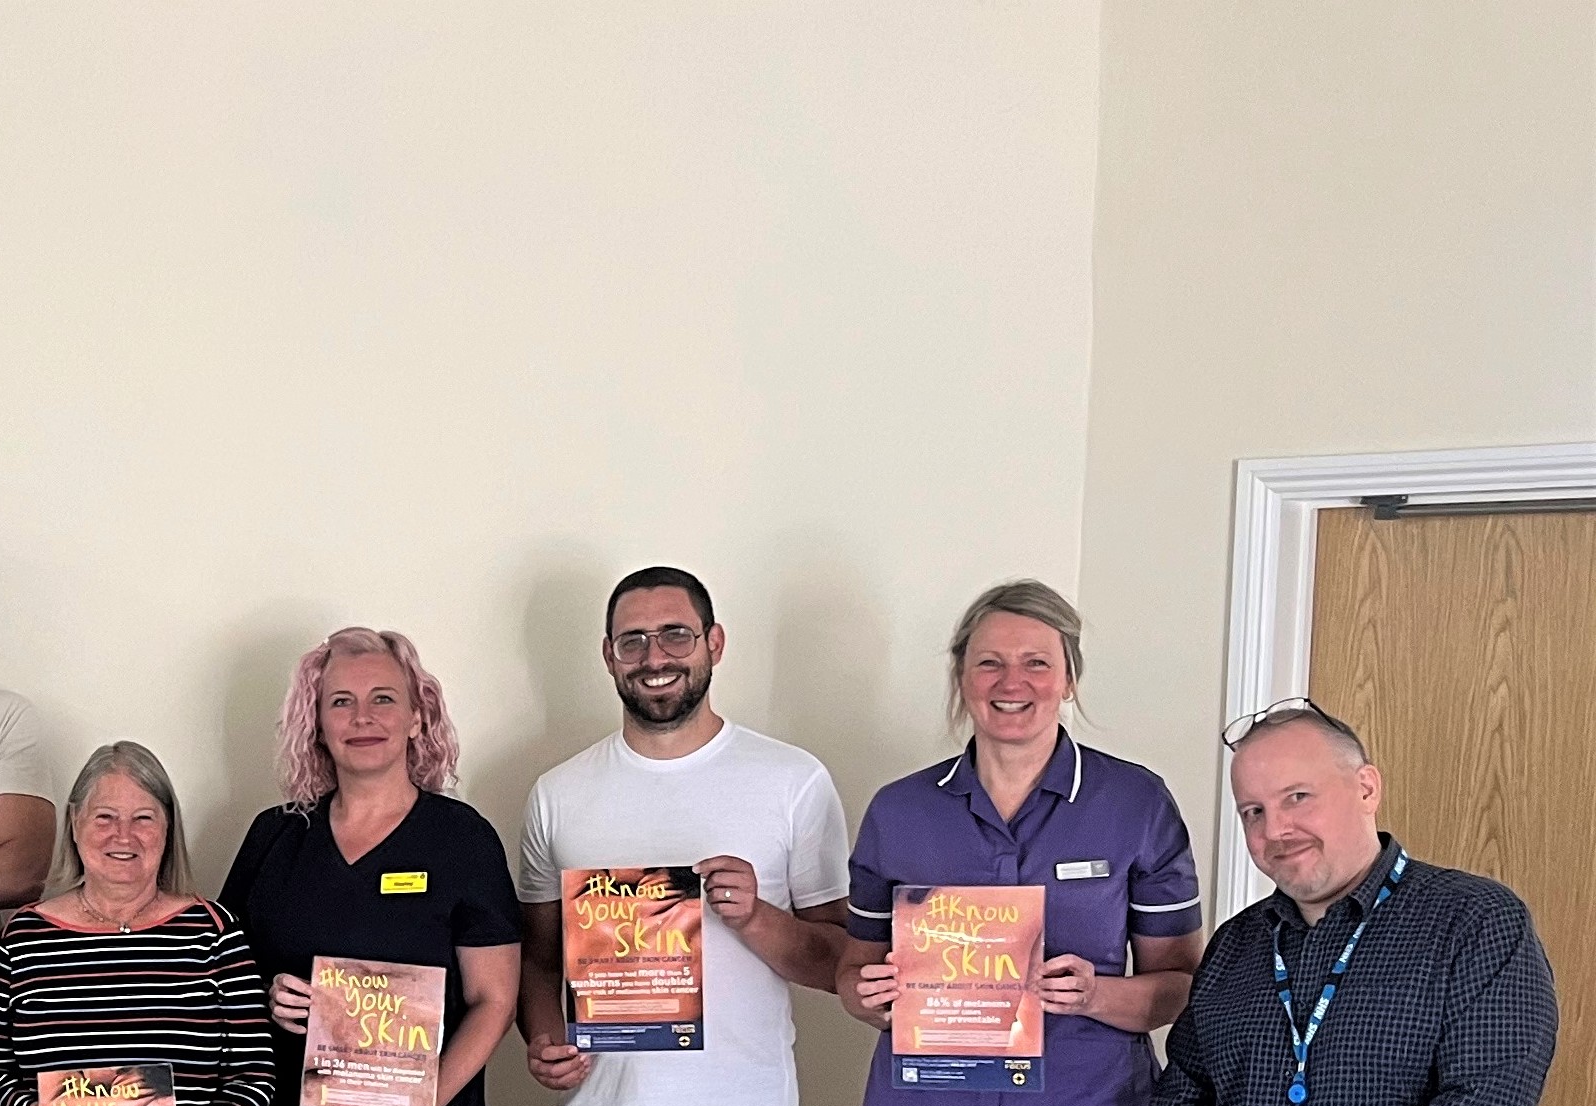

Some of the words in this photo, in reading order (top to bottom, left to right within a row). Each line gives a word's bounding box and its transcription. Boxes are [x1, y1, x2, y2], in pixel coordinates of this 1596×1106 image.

[585, 874, 666, 899] #Know
[575, 899, 641, 930] your
[926, 893, 1019, 923] #Know
[911, 918, 985, 952] your
[319, 967, 389, 989] #Know
[571, 979, 620, 988] sunburns
[652, 976, 693, 986] doubled
[638, 969, 665, 977] more
[683, 966, 690, 976] 5
[345, 988, 408, 1017] your
[1314, 996, 1330, 1020] NHS
[947, 1015, 1002, 1024] preventable
[1305, 1022, 1318, 1046] NHS
[314, 1056, 319, 1066] 1
[321, 1057, 331, 1068] in
[332, 1058, 345, 1069] 36
[347, 1061, 370, 1071] men
[62, 1076, 140, 1099] #Know
